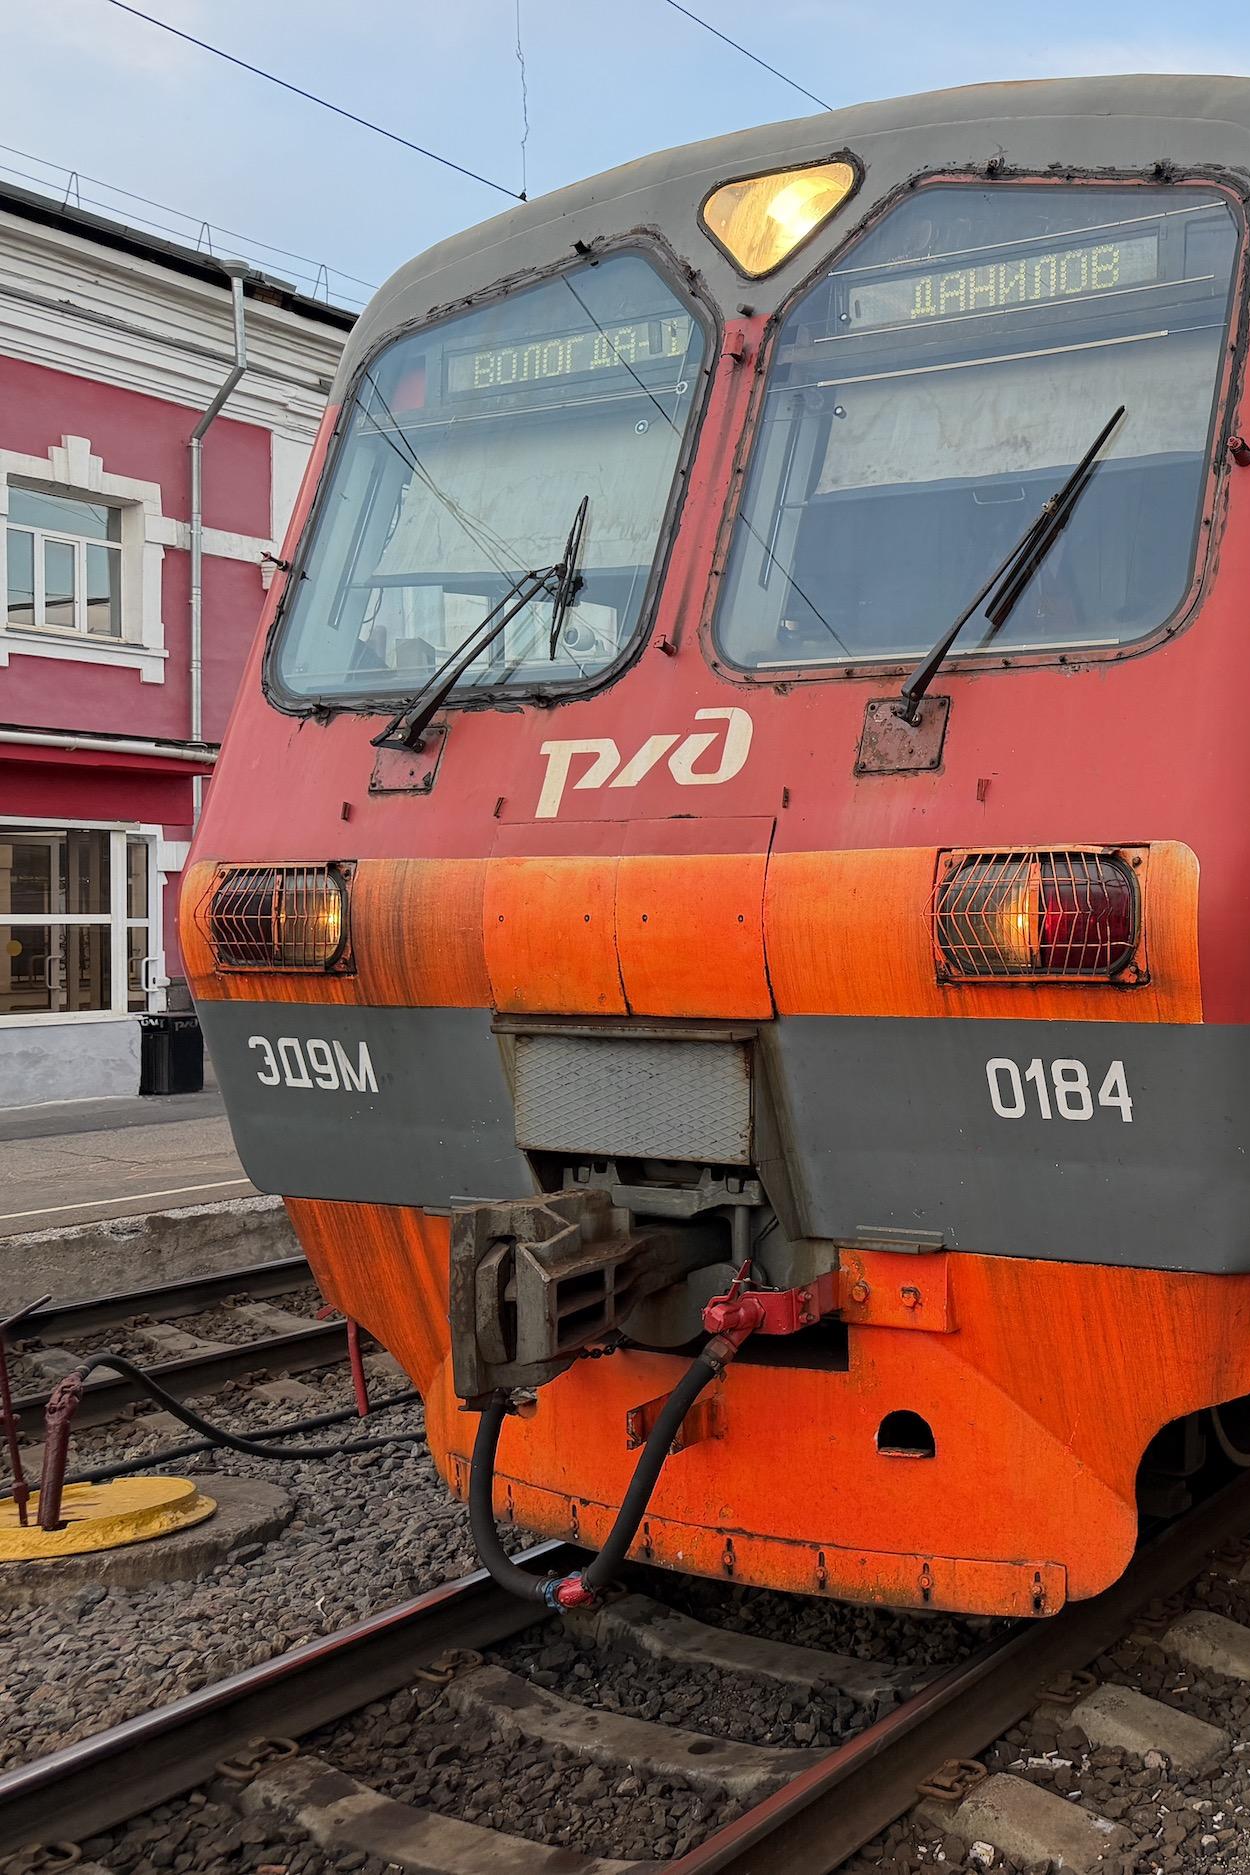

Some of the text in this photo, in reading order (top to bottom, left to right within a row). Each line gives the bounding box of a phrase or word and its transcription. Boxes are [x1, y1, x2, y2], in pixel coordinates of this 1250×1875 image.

[911, 244, 1119, 319] ДАНИЛОВ
[248, 1036, 379, 1093] ЭД9М
[986, 1058, 1133, 1122] 0184
